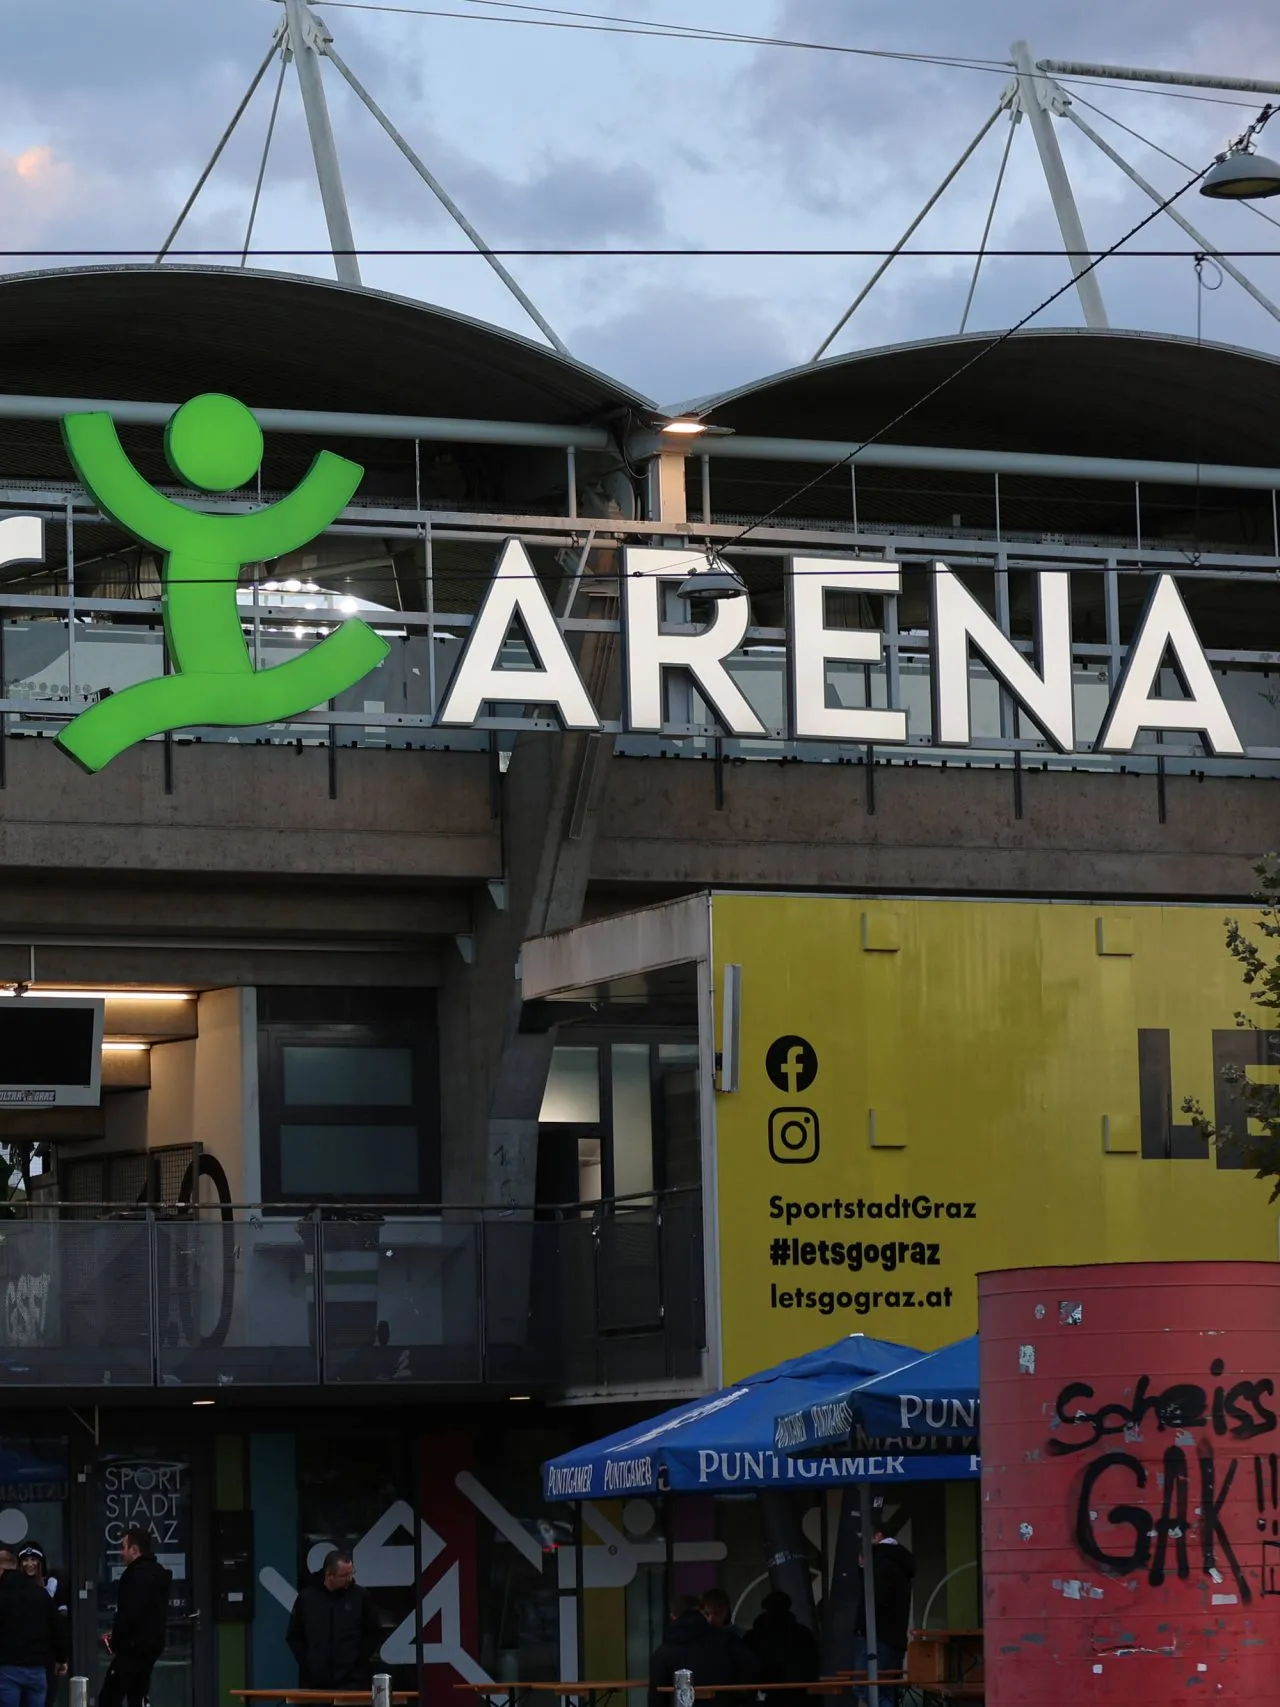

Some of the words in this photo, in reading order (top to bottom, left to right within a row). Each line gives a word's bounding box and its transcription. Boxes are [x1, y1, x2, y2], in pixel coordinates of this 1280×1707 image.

[437, 536, 1245, 757] ARENA
[768, 1194, 977, 1226] SportstadtGraz
[769, 1238, 941, 1272] #letsgograz
[770, 1283, 953, 1315] letsgograz.at
[898, 1394, 981, 1430] PUN
[104, 1467, 181, 1491] SPORT
[547, 1463, 593, 1497] PUNTIGAMER
[105, 1493, 181, 1519] STADT
